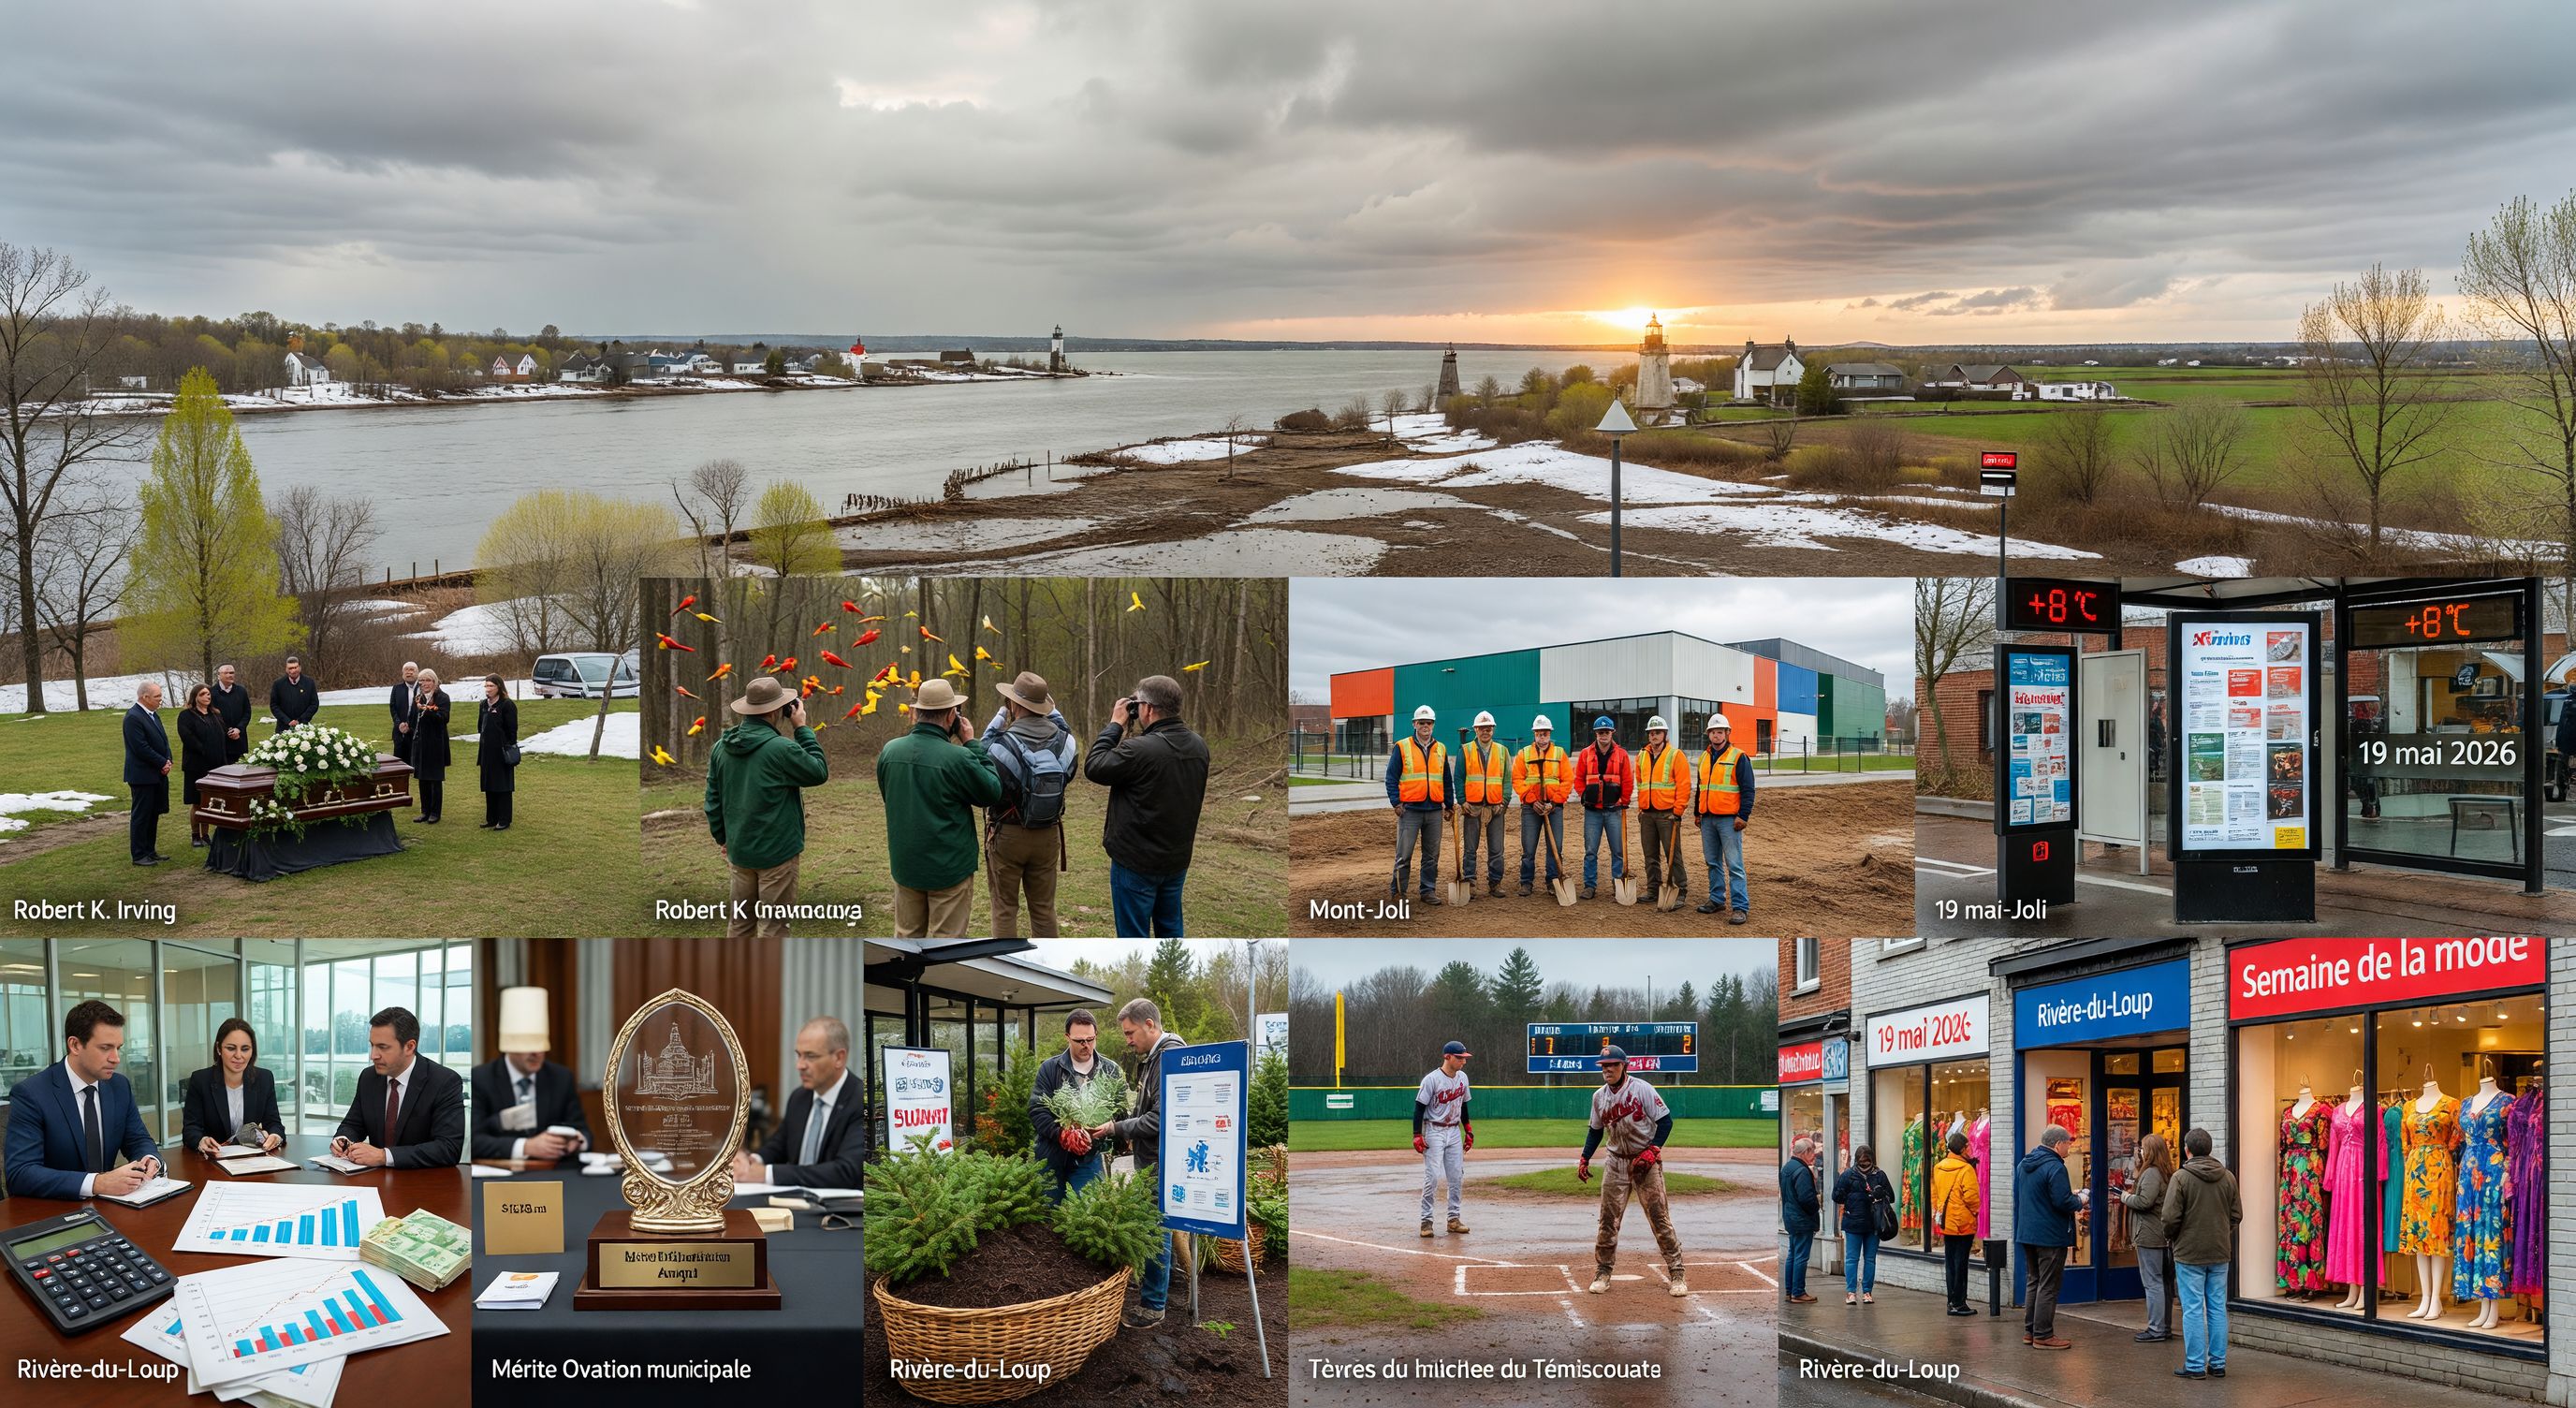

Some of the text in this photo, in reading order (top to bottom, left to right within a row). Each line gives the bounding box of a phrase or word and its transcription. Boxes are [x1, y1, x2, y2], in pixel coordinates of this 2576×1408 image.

[2359, 741, 2516, 766] 19 mai 2026
[2243, 937, 2528, 998] Semaine de la mode
[2038, 990, 2153, 1027] Rivère-du-Loup
[1878, 1025, 1895, 1053] 19
[1898, 1018, 1927, 1049] mai
